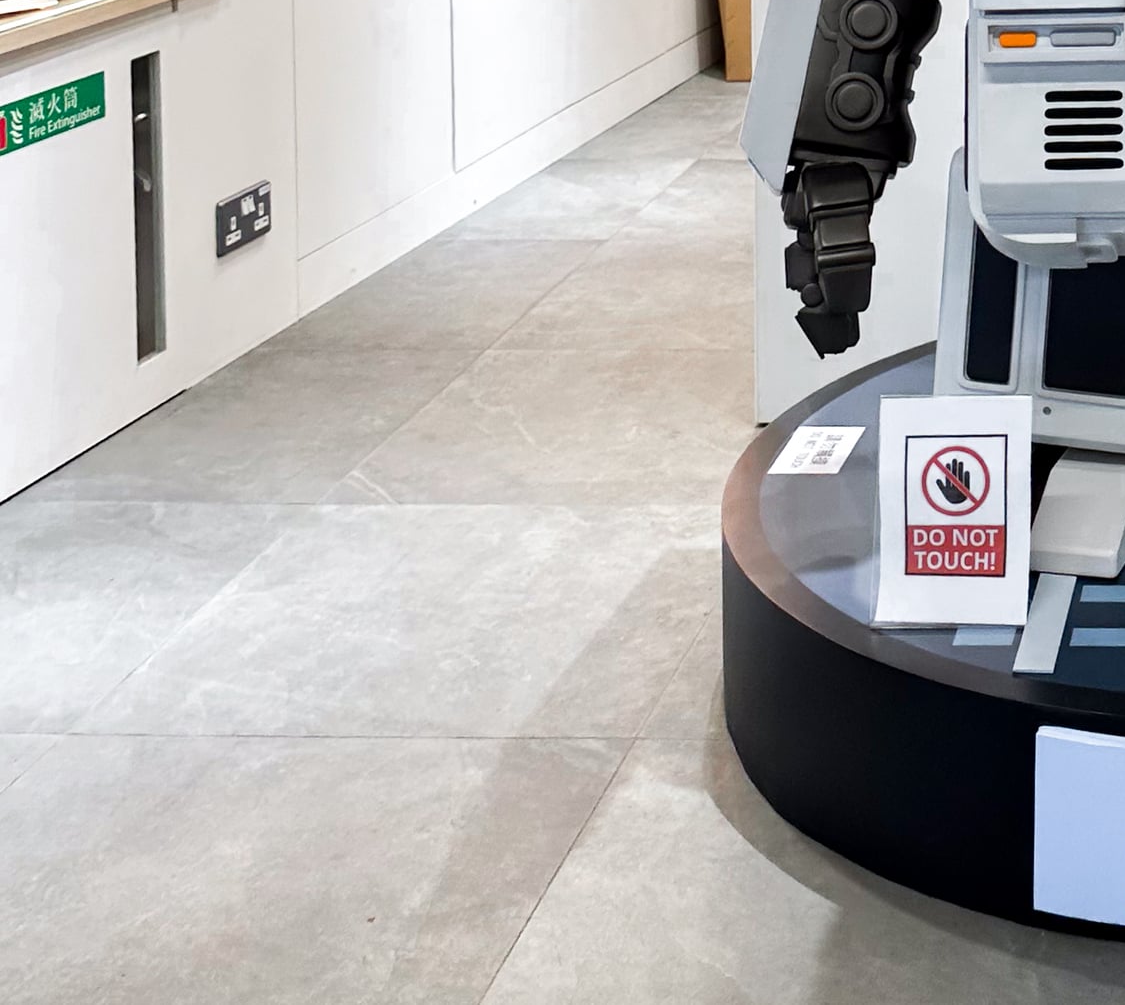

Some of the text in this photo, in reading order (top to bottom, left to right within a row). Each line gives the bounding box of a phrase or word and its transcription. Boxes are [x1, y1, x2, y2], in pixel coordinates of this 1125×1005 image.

[29, 86, 78, 124] 滅火筒
[29, 105, 101, 140] Fire Extinguisher
[913, 529, 999, 547] DO NOT
[914, 551, 996, 571] TOUCH!
